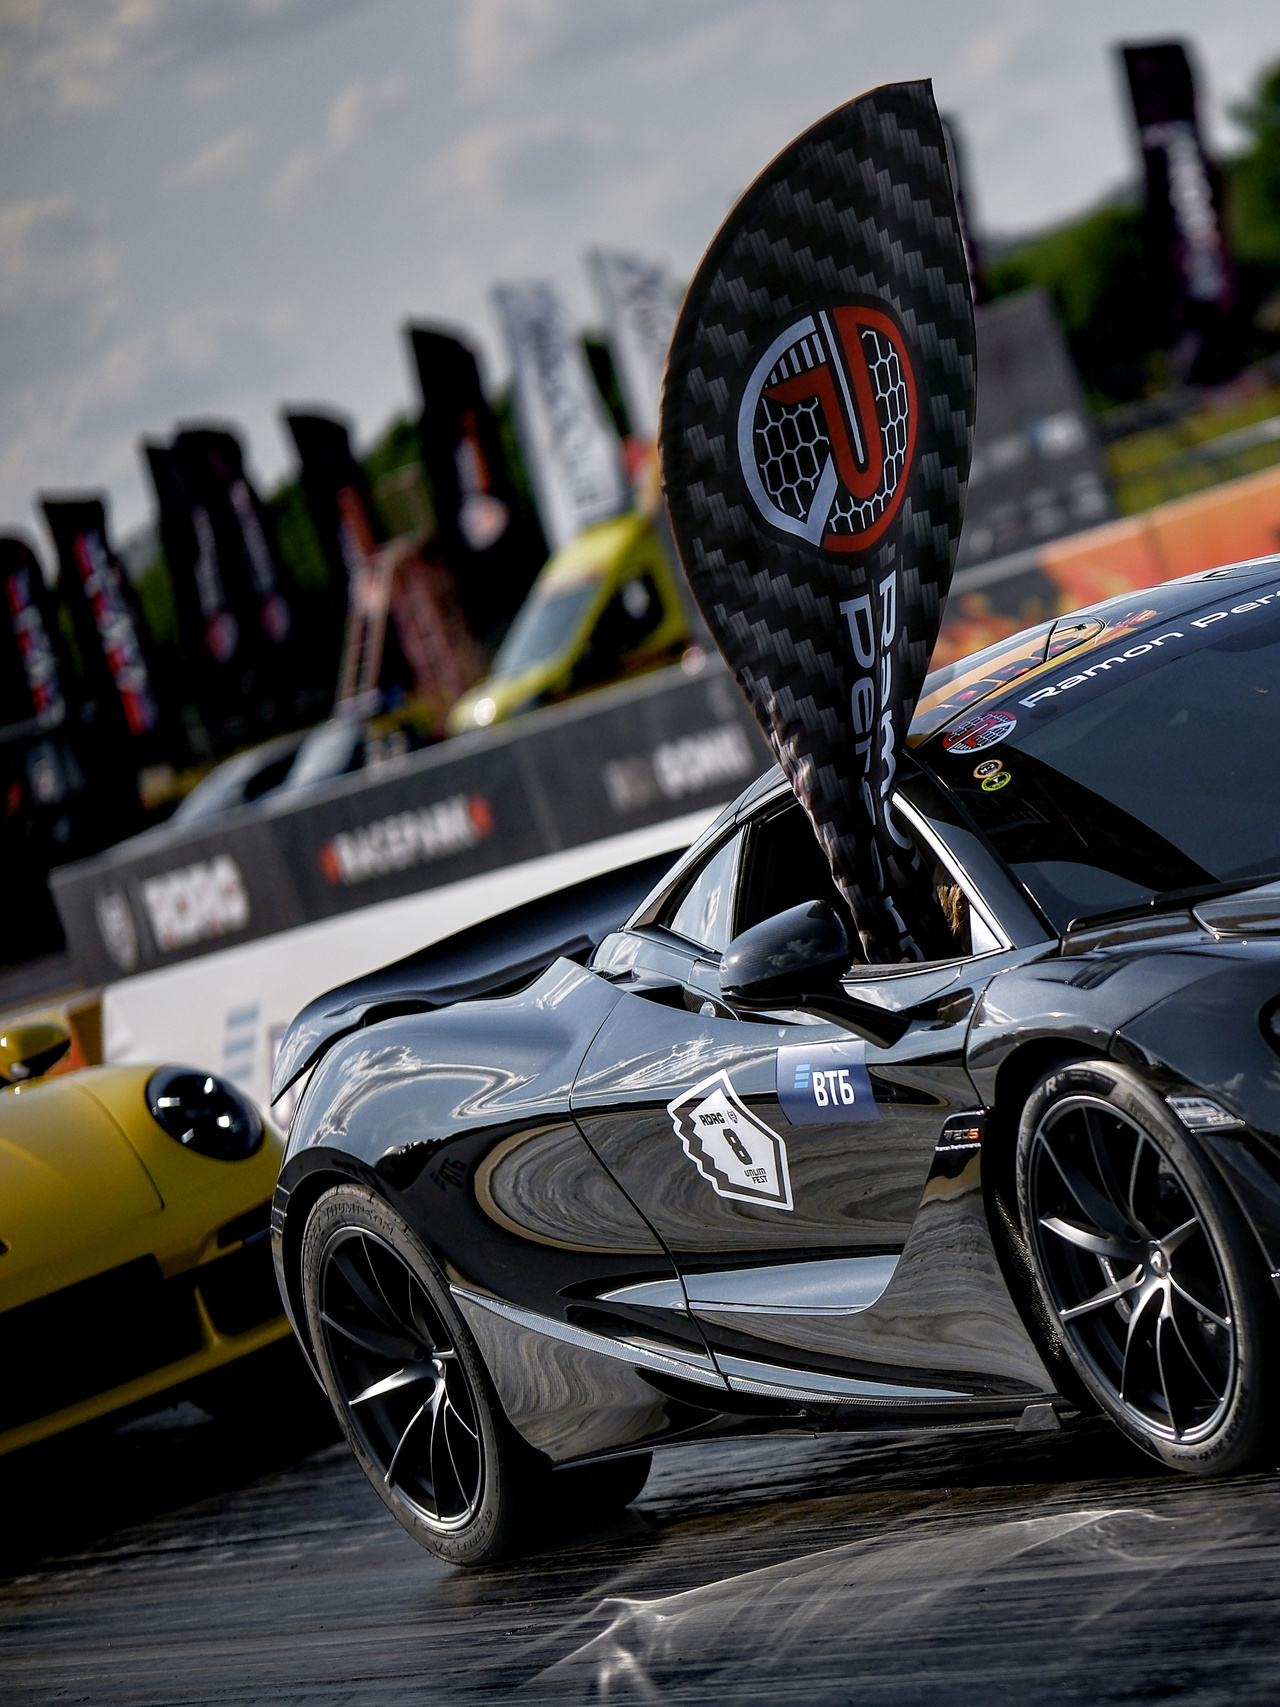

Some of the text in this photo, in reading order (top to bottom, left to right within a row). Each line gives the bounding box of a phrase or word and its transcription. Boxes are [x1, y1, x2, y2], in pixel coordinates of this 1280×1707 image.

[1018, 631, 1185, 709] Ramon
[812, 1069, 855, 1107] ВТБ
[699, 1112, 726, 1126] RDRC
[944, 1127, 980, 1140] 720S
[722, 1128, 753, 1166] 8
[751, 1175, 768, 1184] FEST
